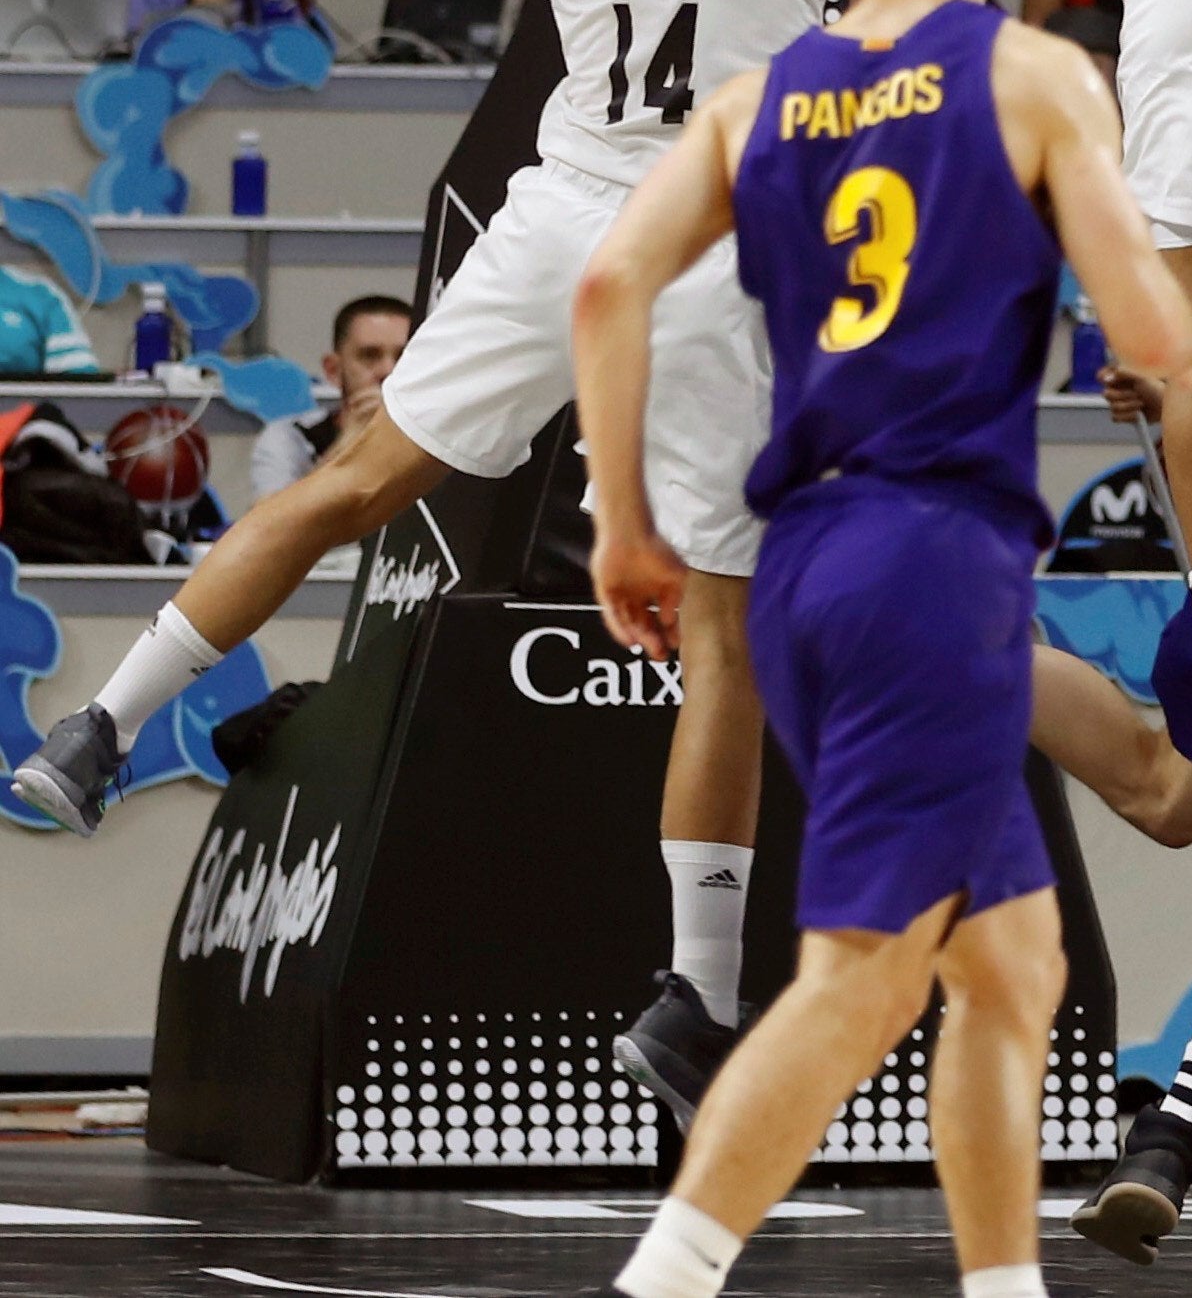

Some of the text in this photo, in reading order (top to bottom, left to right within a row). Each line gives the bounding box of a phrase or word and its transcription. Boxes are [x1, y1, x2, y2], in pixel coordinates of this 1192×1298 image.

[604, 3, 698, 125] 14
[780, 64, 944, 140] PANGOS
[817, 164, 918, 353] 3
